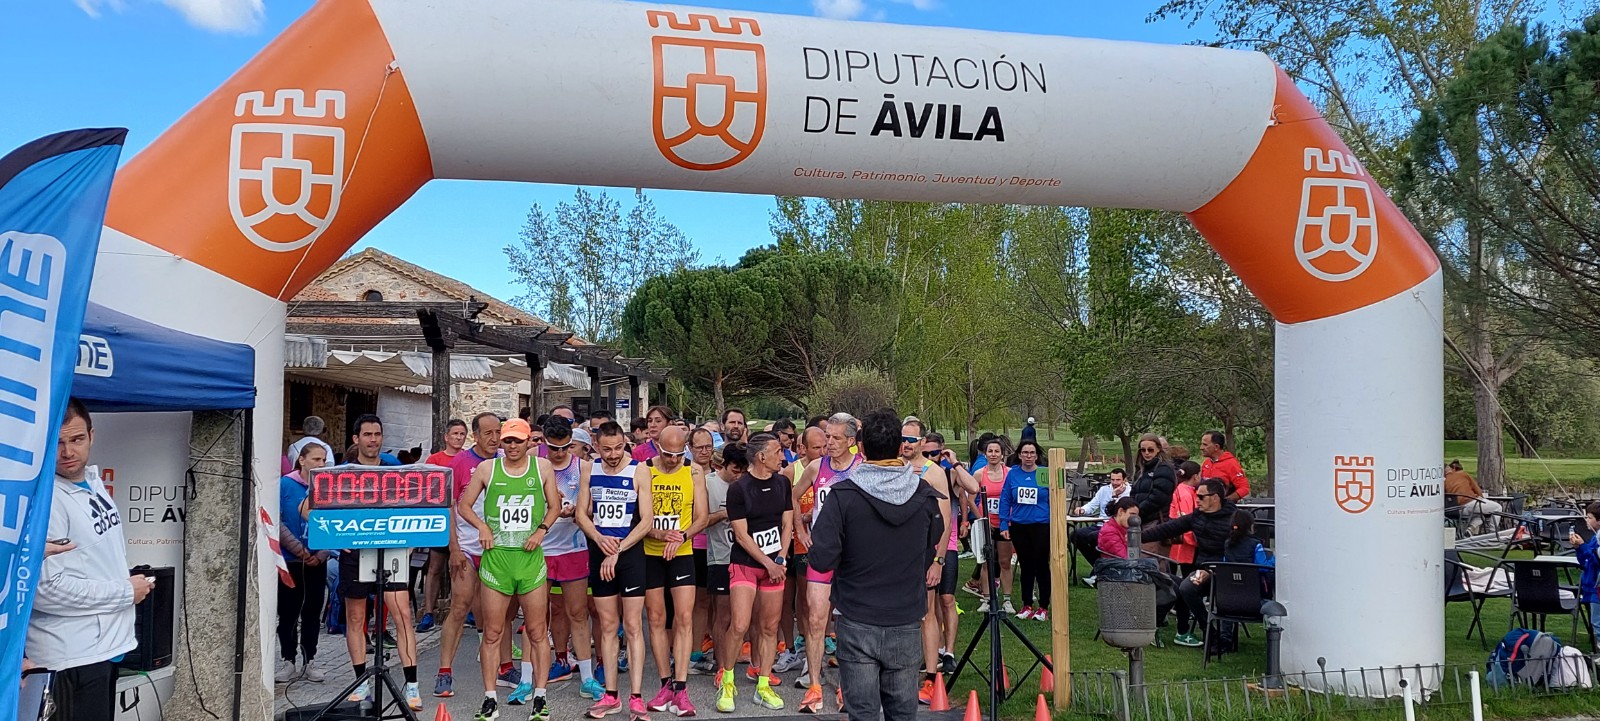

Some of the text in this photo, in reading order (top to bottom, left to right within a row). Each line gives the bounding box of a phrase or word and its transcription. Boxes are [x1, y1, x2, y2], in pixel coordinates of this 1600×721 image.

[802, 47, 1047, 93] DIPUTACIÓN
[803, 96, 858, 135] DE
[793, 167, 1061, 188] Cultura, Patrimonio, Juventud y Deporte
[129, 485, 188, 502] DIPUT
[314, 472, 446, 505] 00:00:00
[1019, 488, 1036, 499] 092
[1387, 485, 1406, 498] DE
[496, 494, 535, 507] LEA
[987, 499, 999, 510] 15
[129, 507, 155, 523] DE
[502, 508, 529, 524] 049
[599, 504, 623, 519] 095
[654, 517, 678, 530] 007
[756, 529, 779, 548] 022
